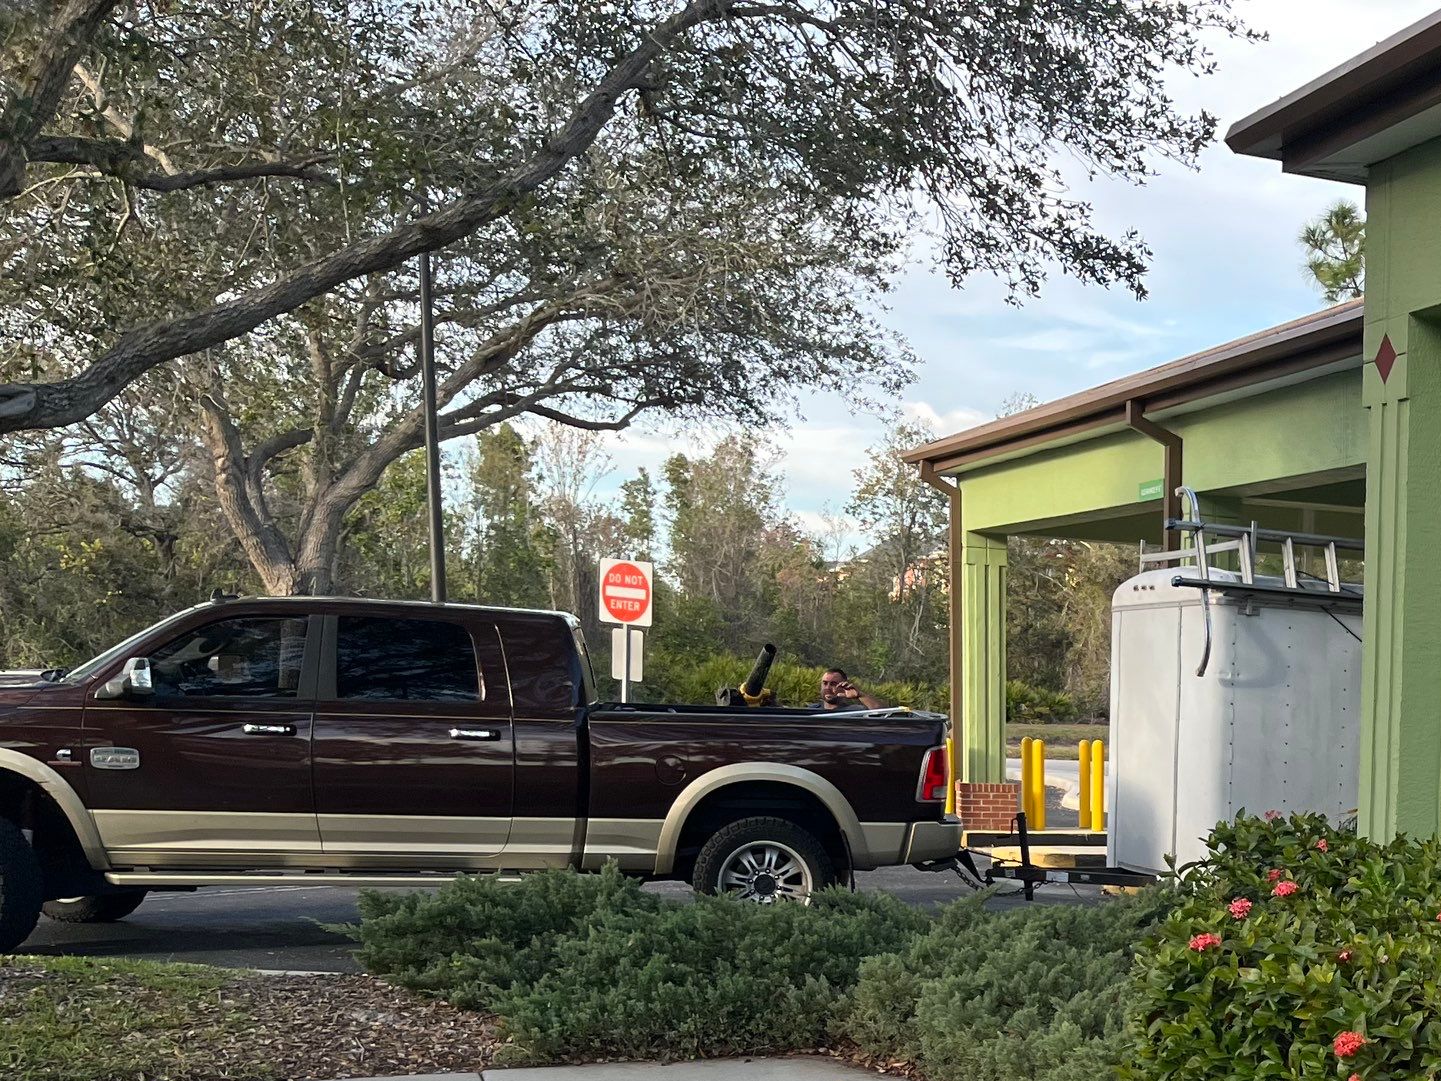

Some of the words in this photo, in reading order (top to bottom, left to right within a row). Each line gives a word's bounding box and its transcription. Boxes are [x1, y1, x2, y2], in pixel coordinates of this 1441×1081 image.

[609, 573, 622, 584] DO
[624, 575, 643, 586] NOT
[610, 599, 640, 611] ENTER
